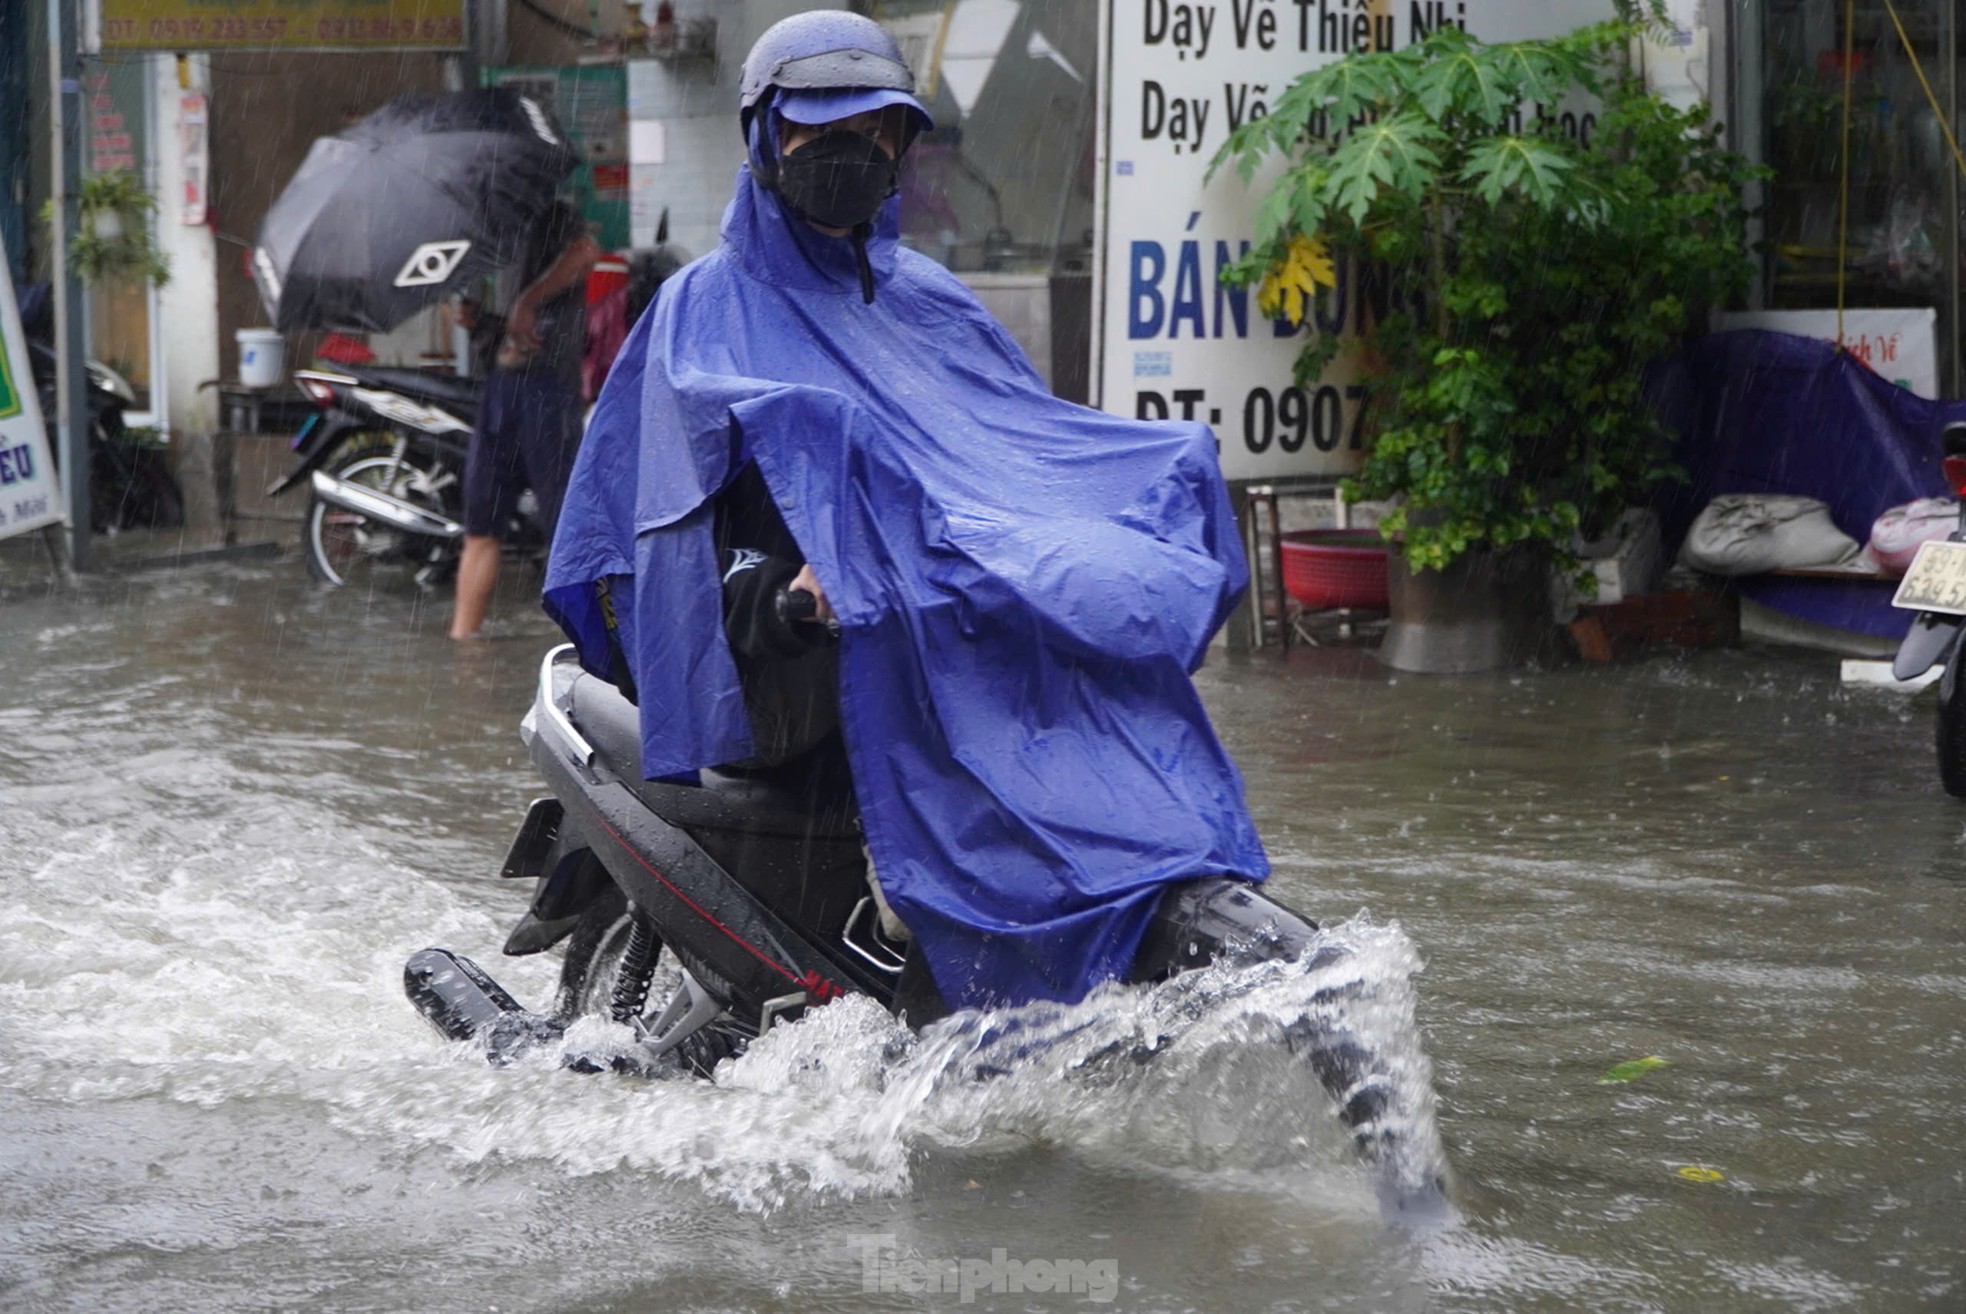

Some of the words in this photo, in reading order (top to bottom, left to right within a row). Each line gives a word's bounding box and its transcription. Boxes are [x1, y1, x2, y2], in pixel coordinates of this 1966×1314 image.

[1144, 0, 1215, 61] Dạy
[1141, 80, 1210, 154] Dạy
[1128, 211, 1250, 340] BÁN
